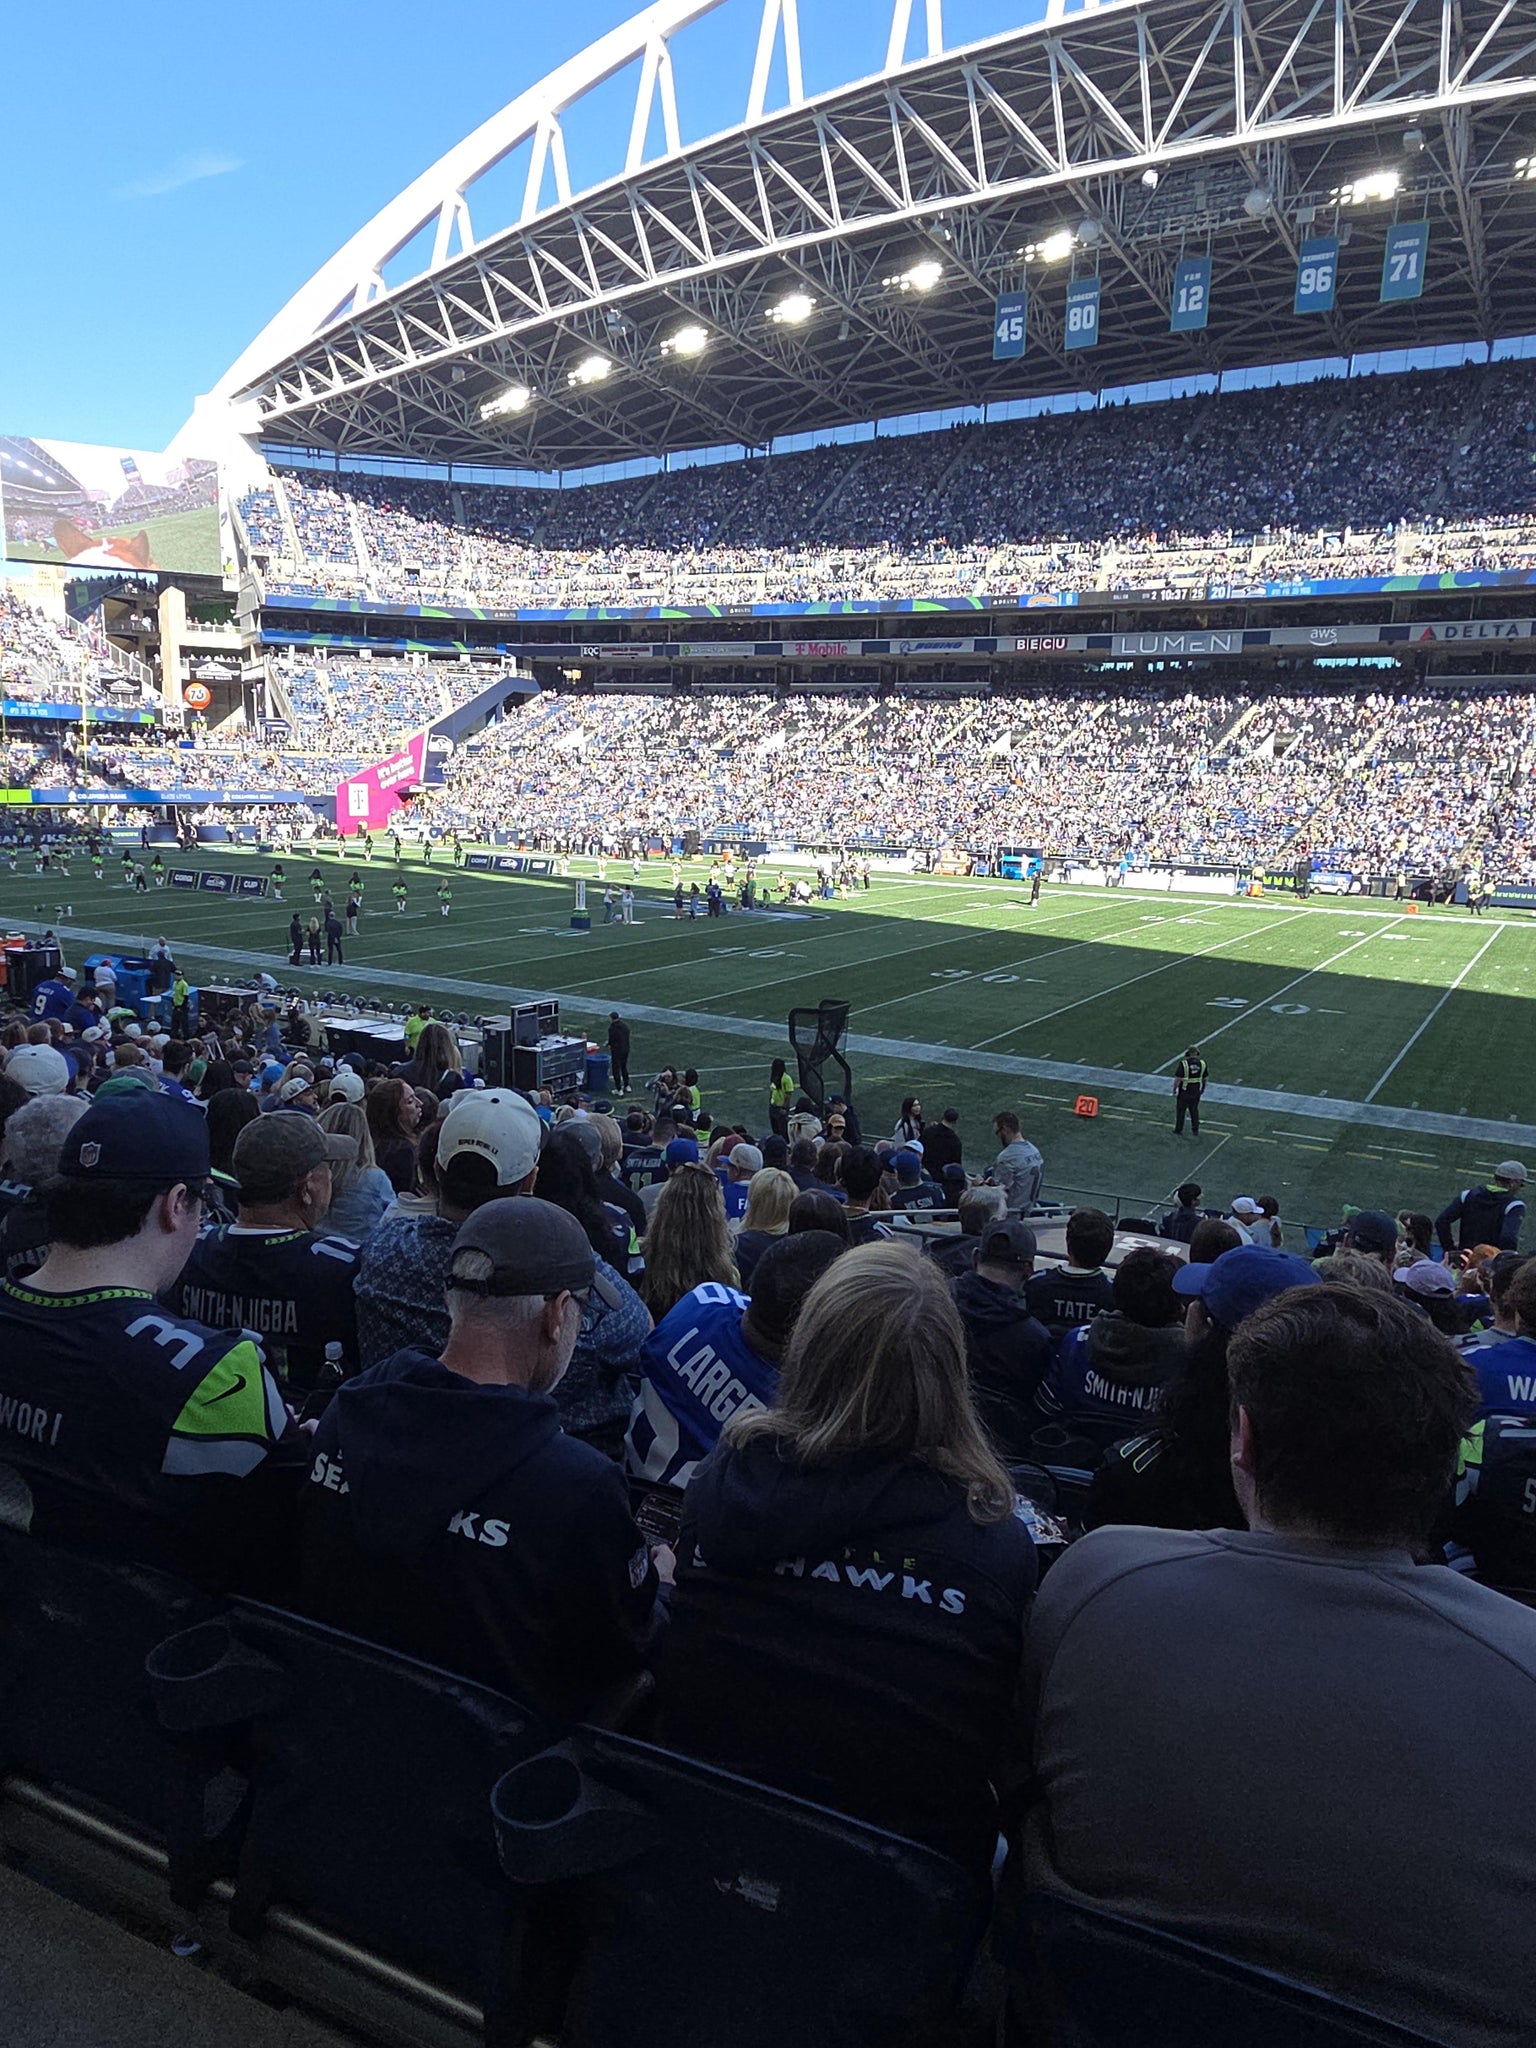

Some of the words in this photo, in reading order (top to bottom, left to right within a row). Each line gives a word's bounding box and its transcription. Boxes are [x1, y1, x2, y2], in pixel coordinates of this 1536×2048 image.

[1390, 252, 1418, 282] 71
[1300, 266, 1333, 295] 96
[1178, 285, 1204, 313] 12
[1069, 305, 1096, 332] 80
[997, 317, 1023, 343] 45
[1151, 591, 1157, 601] 2
[1161, 589, 1187, 601] 10:37
[1191, 588, 1204, 600] 25
[1211, 587, 1226, 599] 20
[1310, 628, 1337, 639] aws
[1445, 624, 1519, 638] DELTA
[583, 646, 599, 656] EQC
[1121, 634, 1231, 654] LUMEN
[243, 880, 258, 888] CUP
[35, 994, 47, 1016] 9
[1079, 1097, 1095, 1115] 20
[628, 1172, 653, 1193] 11
[181, 1284, 299, 1334] SMITH-NJIGBA
[1053, 1299, 1097, 1320] TATE
[124, 1314, 205, 1371] 3
